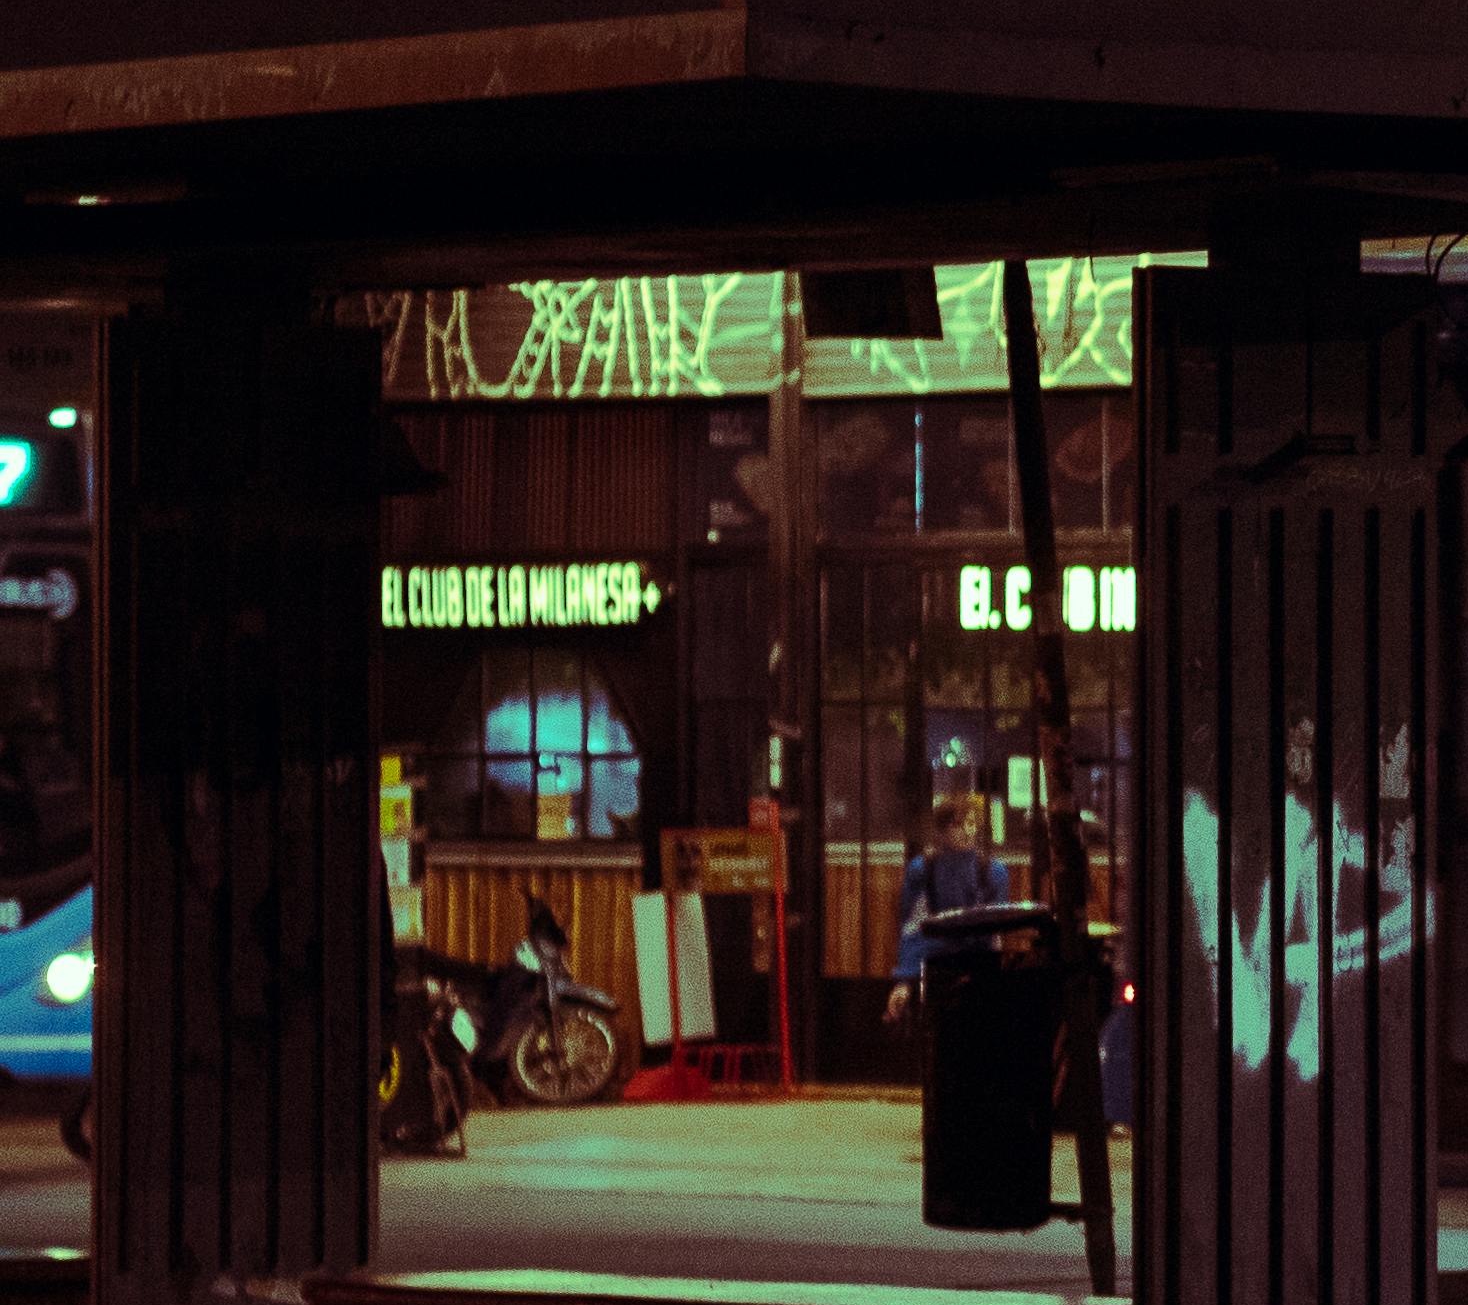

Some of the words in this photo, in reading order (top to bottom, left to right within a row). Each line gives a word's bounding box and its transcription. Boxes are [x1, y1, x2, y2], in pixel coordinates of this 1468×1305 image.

[381, 565, 406, 628] EL
[407, 565, 464, 628] CLUB
[465, 565, 495, 628] DE
[498, 565, 526, 628] LA
[529, 561, 641, 627] MILANESA
